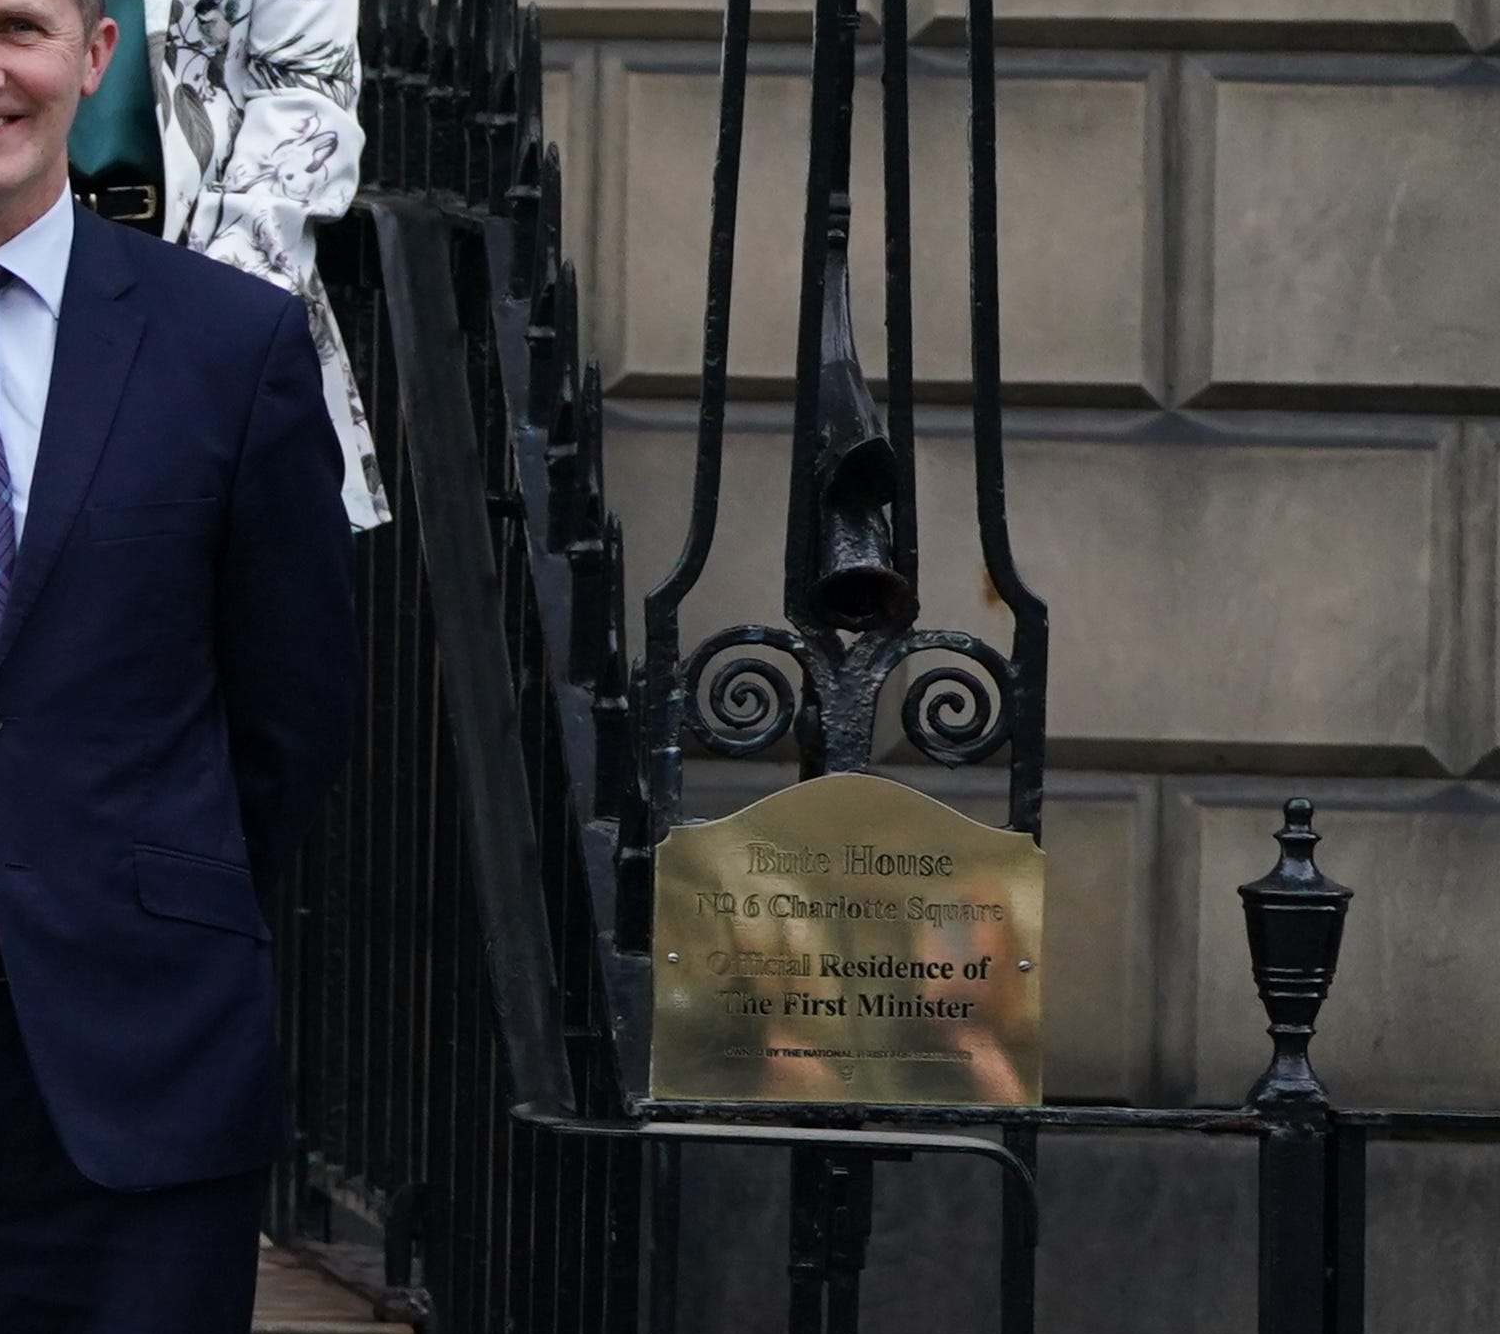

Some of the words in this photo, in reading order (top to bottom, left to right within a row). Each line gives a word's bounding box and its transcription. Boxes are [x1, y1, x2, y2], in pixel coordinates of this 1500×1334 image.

[746, 841, 831, 875] Bute
[844, 844, 953, 877] House
[743, 893, 761, 917] 6
[768, 893, 897, 920] Charlotte
[906, 896, 1004, 928] Square
[707, 950, 811, 977] Official
[818, 953, 954, 979] Residence
[963, 955, 991, 980] of
[720, 990, 773, 1016] The
[782, 992, 847, 1017] First
[857, 993, 975, 1018] Minister
[725, 1047, 764, 1057] OWND
[782, 1049, 804, 1058] THE
[804, 1049, 853, 1058] NATIONAL
